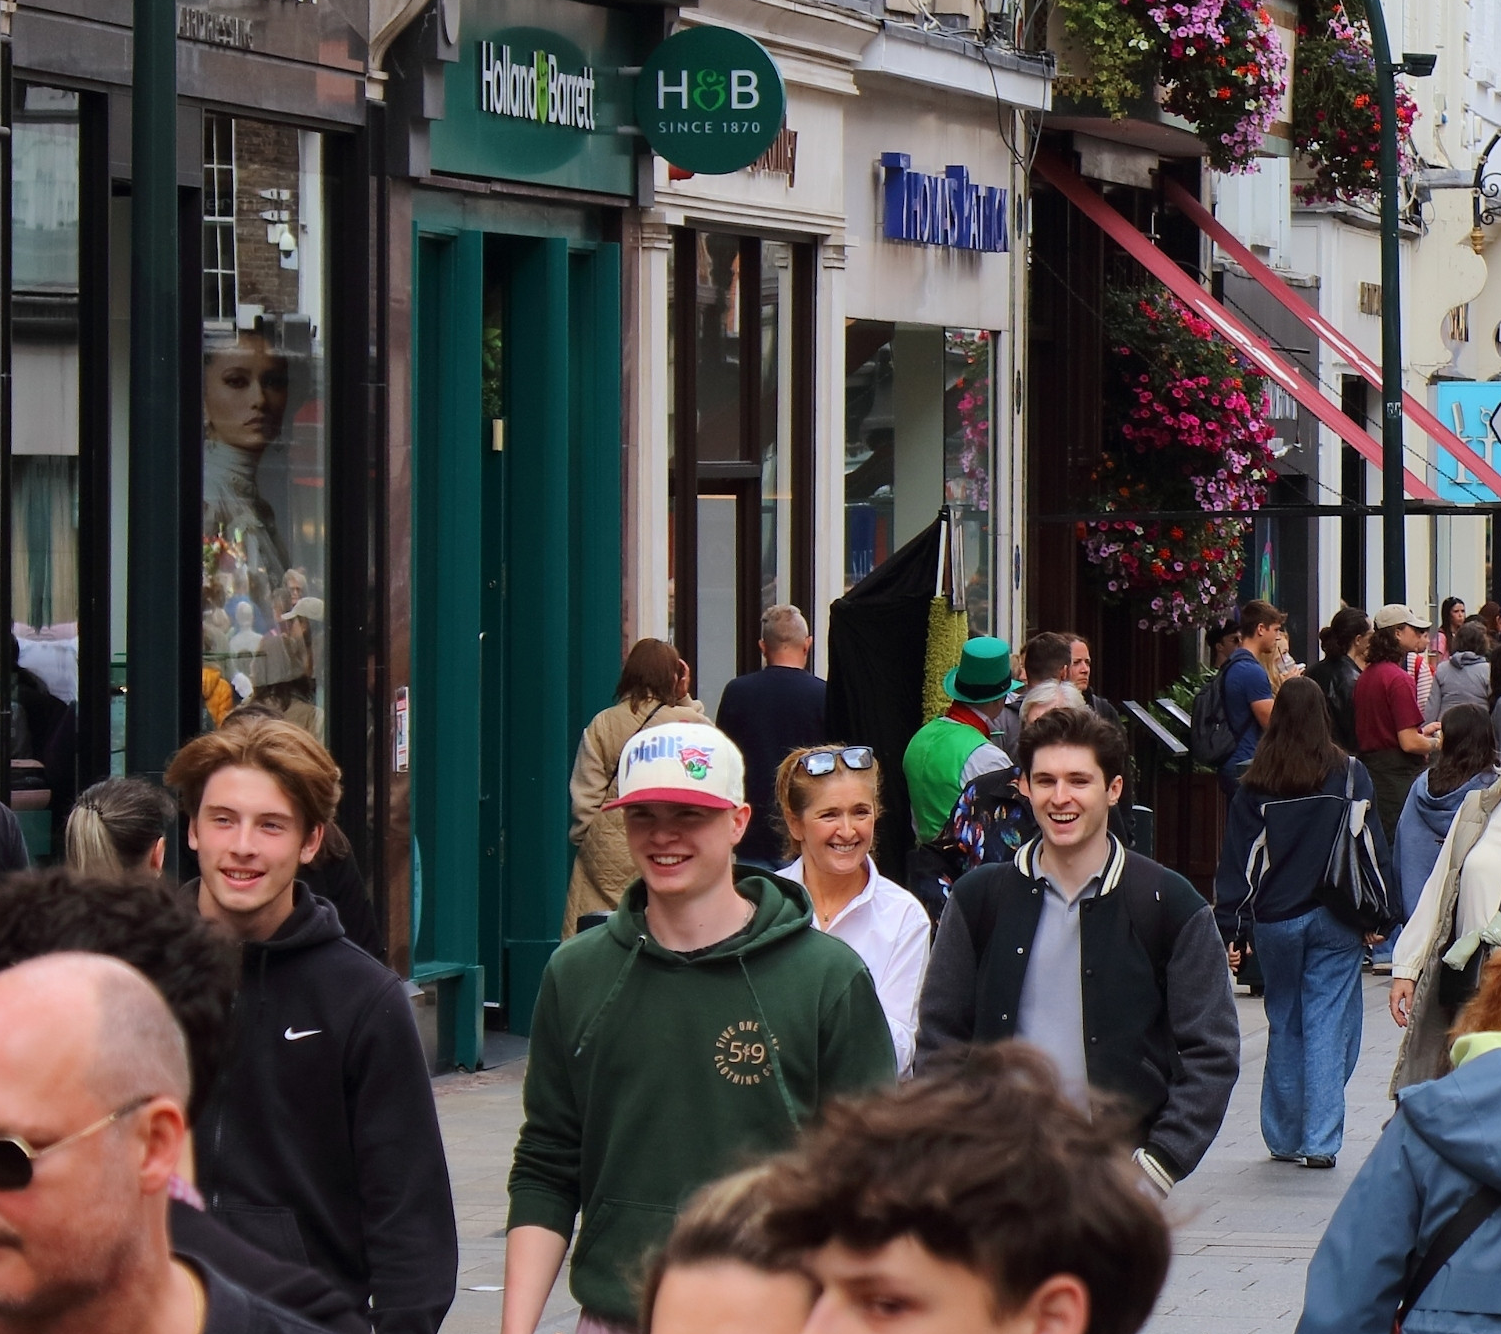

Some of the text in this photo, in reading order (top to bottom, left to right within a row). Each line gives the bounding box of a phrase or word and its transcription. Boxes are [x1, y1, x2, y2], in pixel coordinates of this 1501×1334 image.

[481, 40, 537, 120] Holland
[548, 53, 595, 131] Barrett
[658, 121, 761, 134] SINCE 1870
[881, 152, 958, 246] THOMAS
[716, 1026, 736, 1048] FIVE
[738, 1021, 759, 1032] ONE
[714, 1055, 760, 1085] CLOTHING
